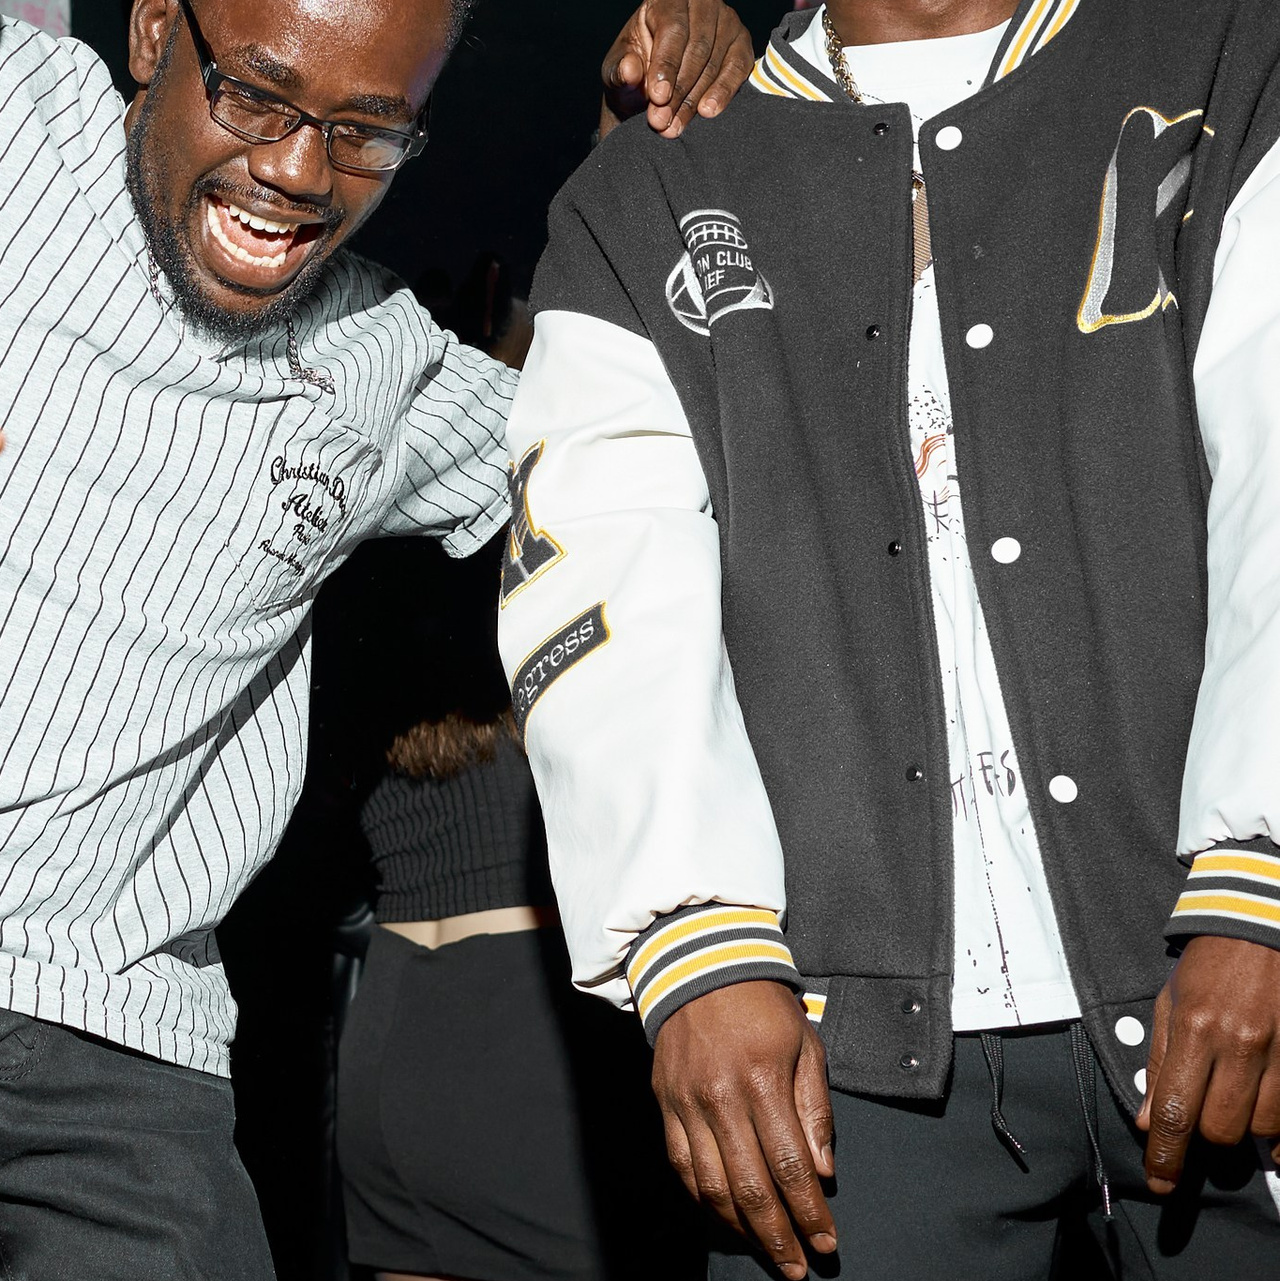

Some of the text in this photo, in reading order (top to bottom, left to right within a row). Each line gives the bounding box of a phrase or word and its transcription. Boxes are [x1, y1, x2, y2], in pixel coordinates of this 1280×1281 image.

[716, 250, 754, 272] CLUB
[270, 455, 330, 490] Christian
[281, 493, 328, 533] Atelier
